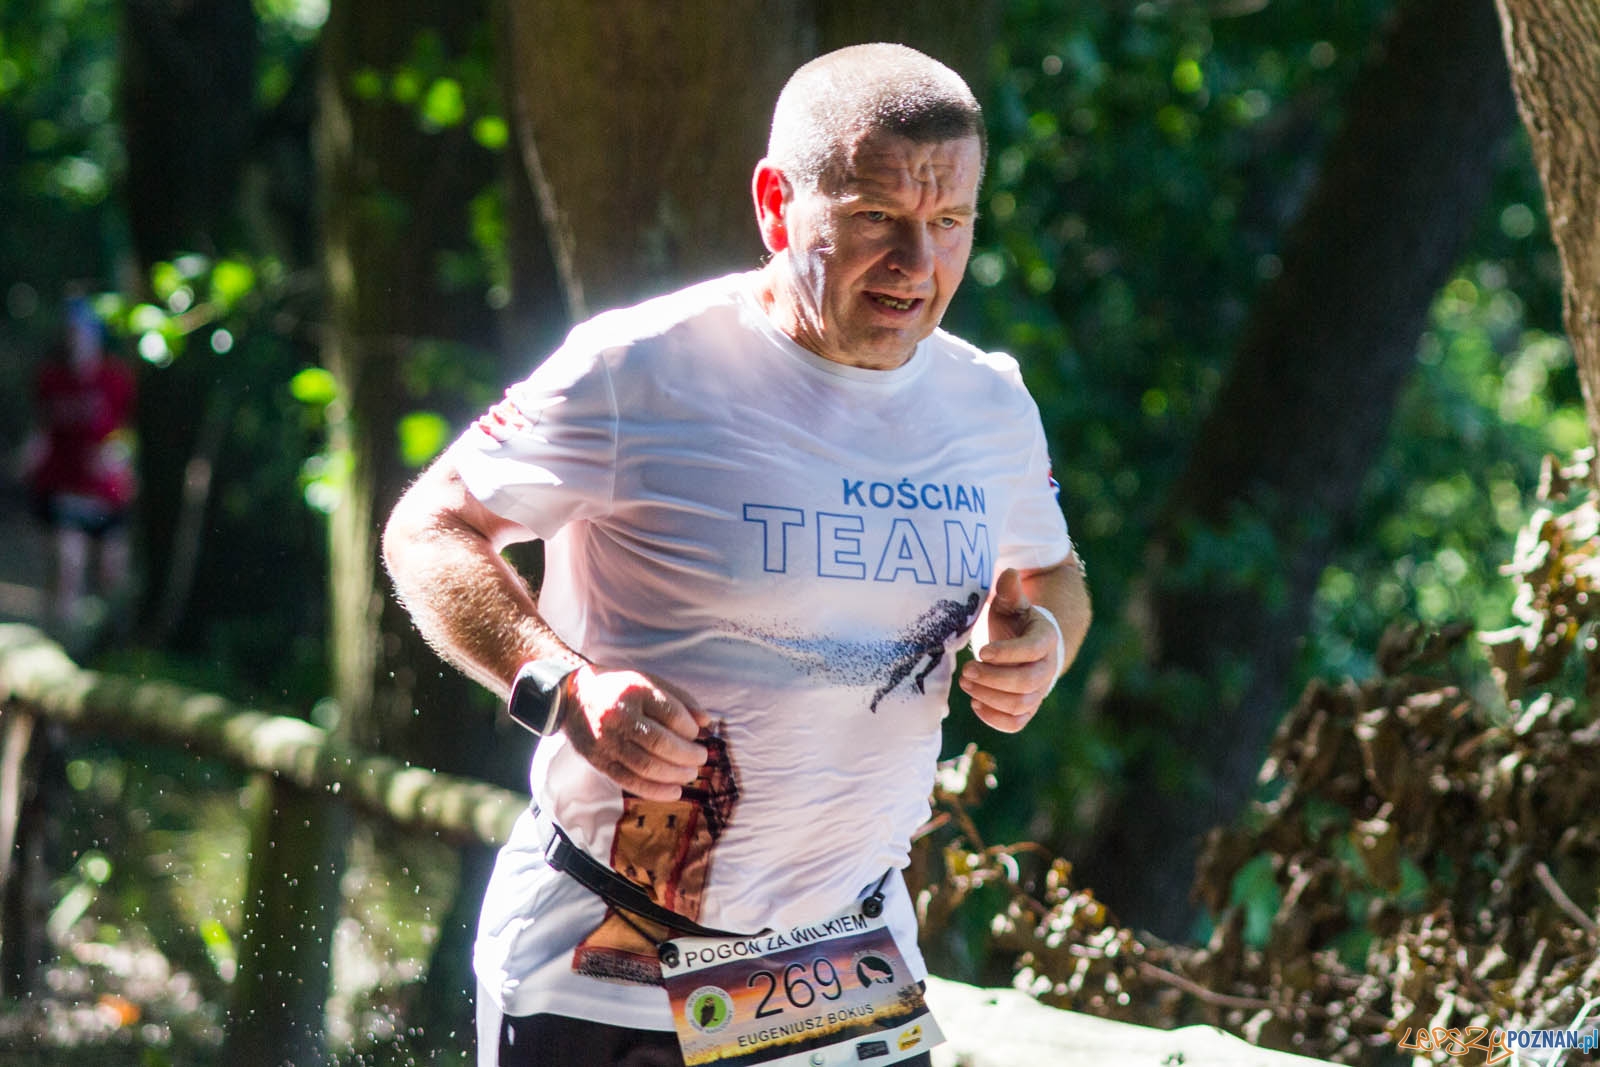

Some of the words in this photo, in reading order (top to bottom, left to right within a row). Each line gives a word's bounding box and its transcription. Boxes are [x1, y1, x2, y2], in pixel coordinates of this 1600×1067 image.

[842, 477, 986, 514] KOŚCIAN
[743, 503, 993, 590] TEAM
[767, 935, 791, 951] ZA
[747, 957, 842, 1019] 269
[737, 1016, 824, 1047] EUGENIUSZ
[827, 1003, 874, 1024] BOKUS
